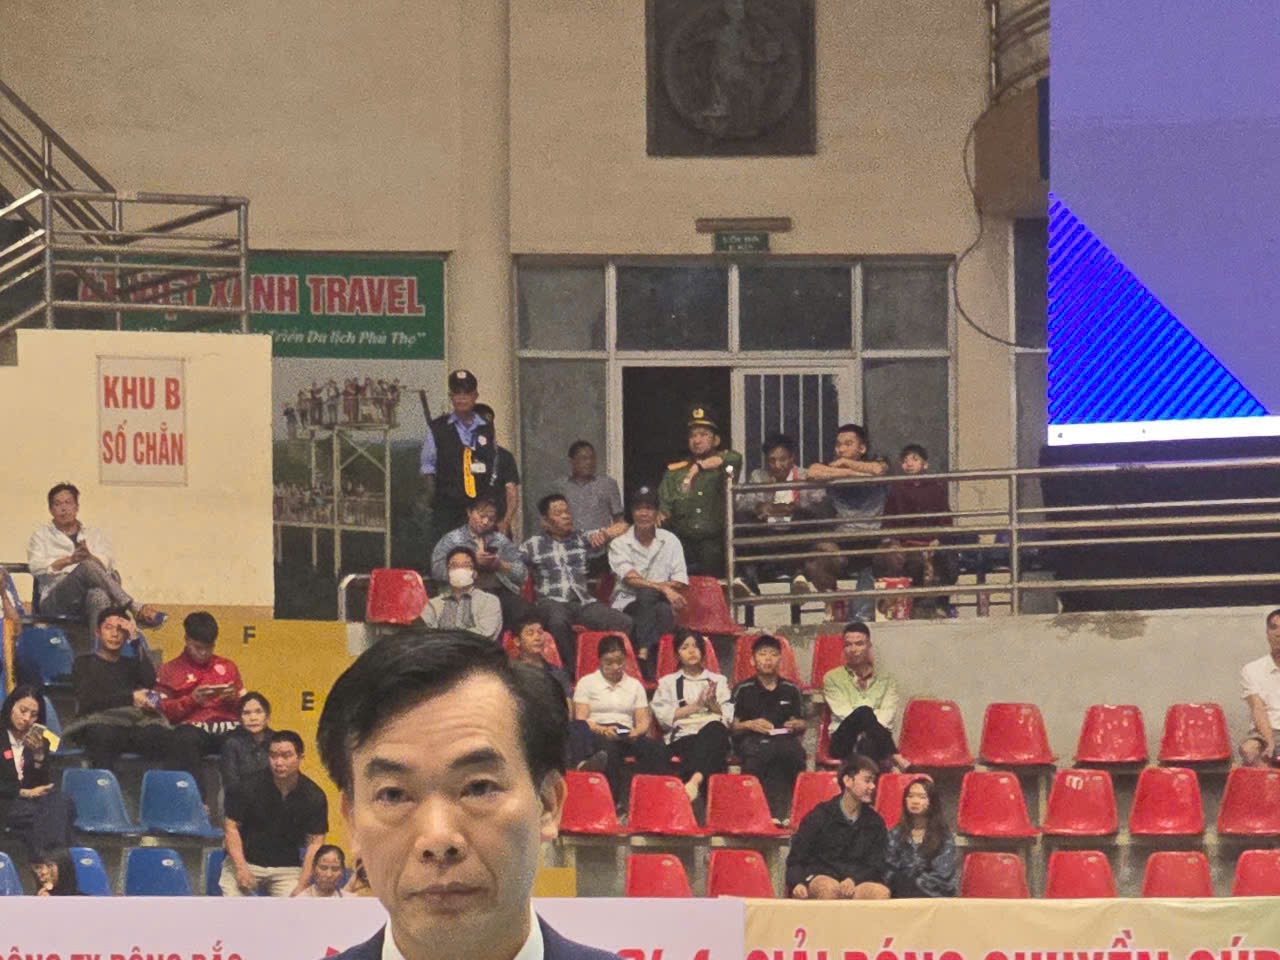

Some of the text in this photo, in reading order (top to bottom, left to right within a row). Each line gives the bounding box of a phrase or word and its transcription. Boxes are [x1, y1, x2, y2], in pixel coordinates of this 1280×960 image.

[306, 275, 426, 316] TRAVEL
[103, 375, 181, 411] KHU B
[102, 420, 127, 466] SỐ
[243, 626, 256, 644] F
[301, 691, 315, 711] E
